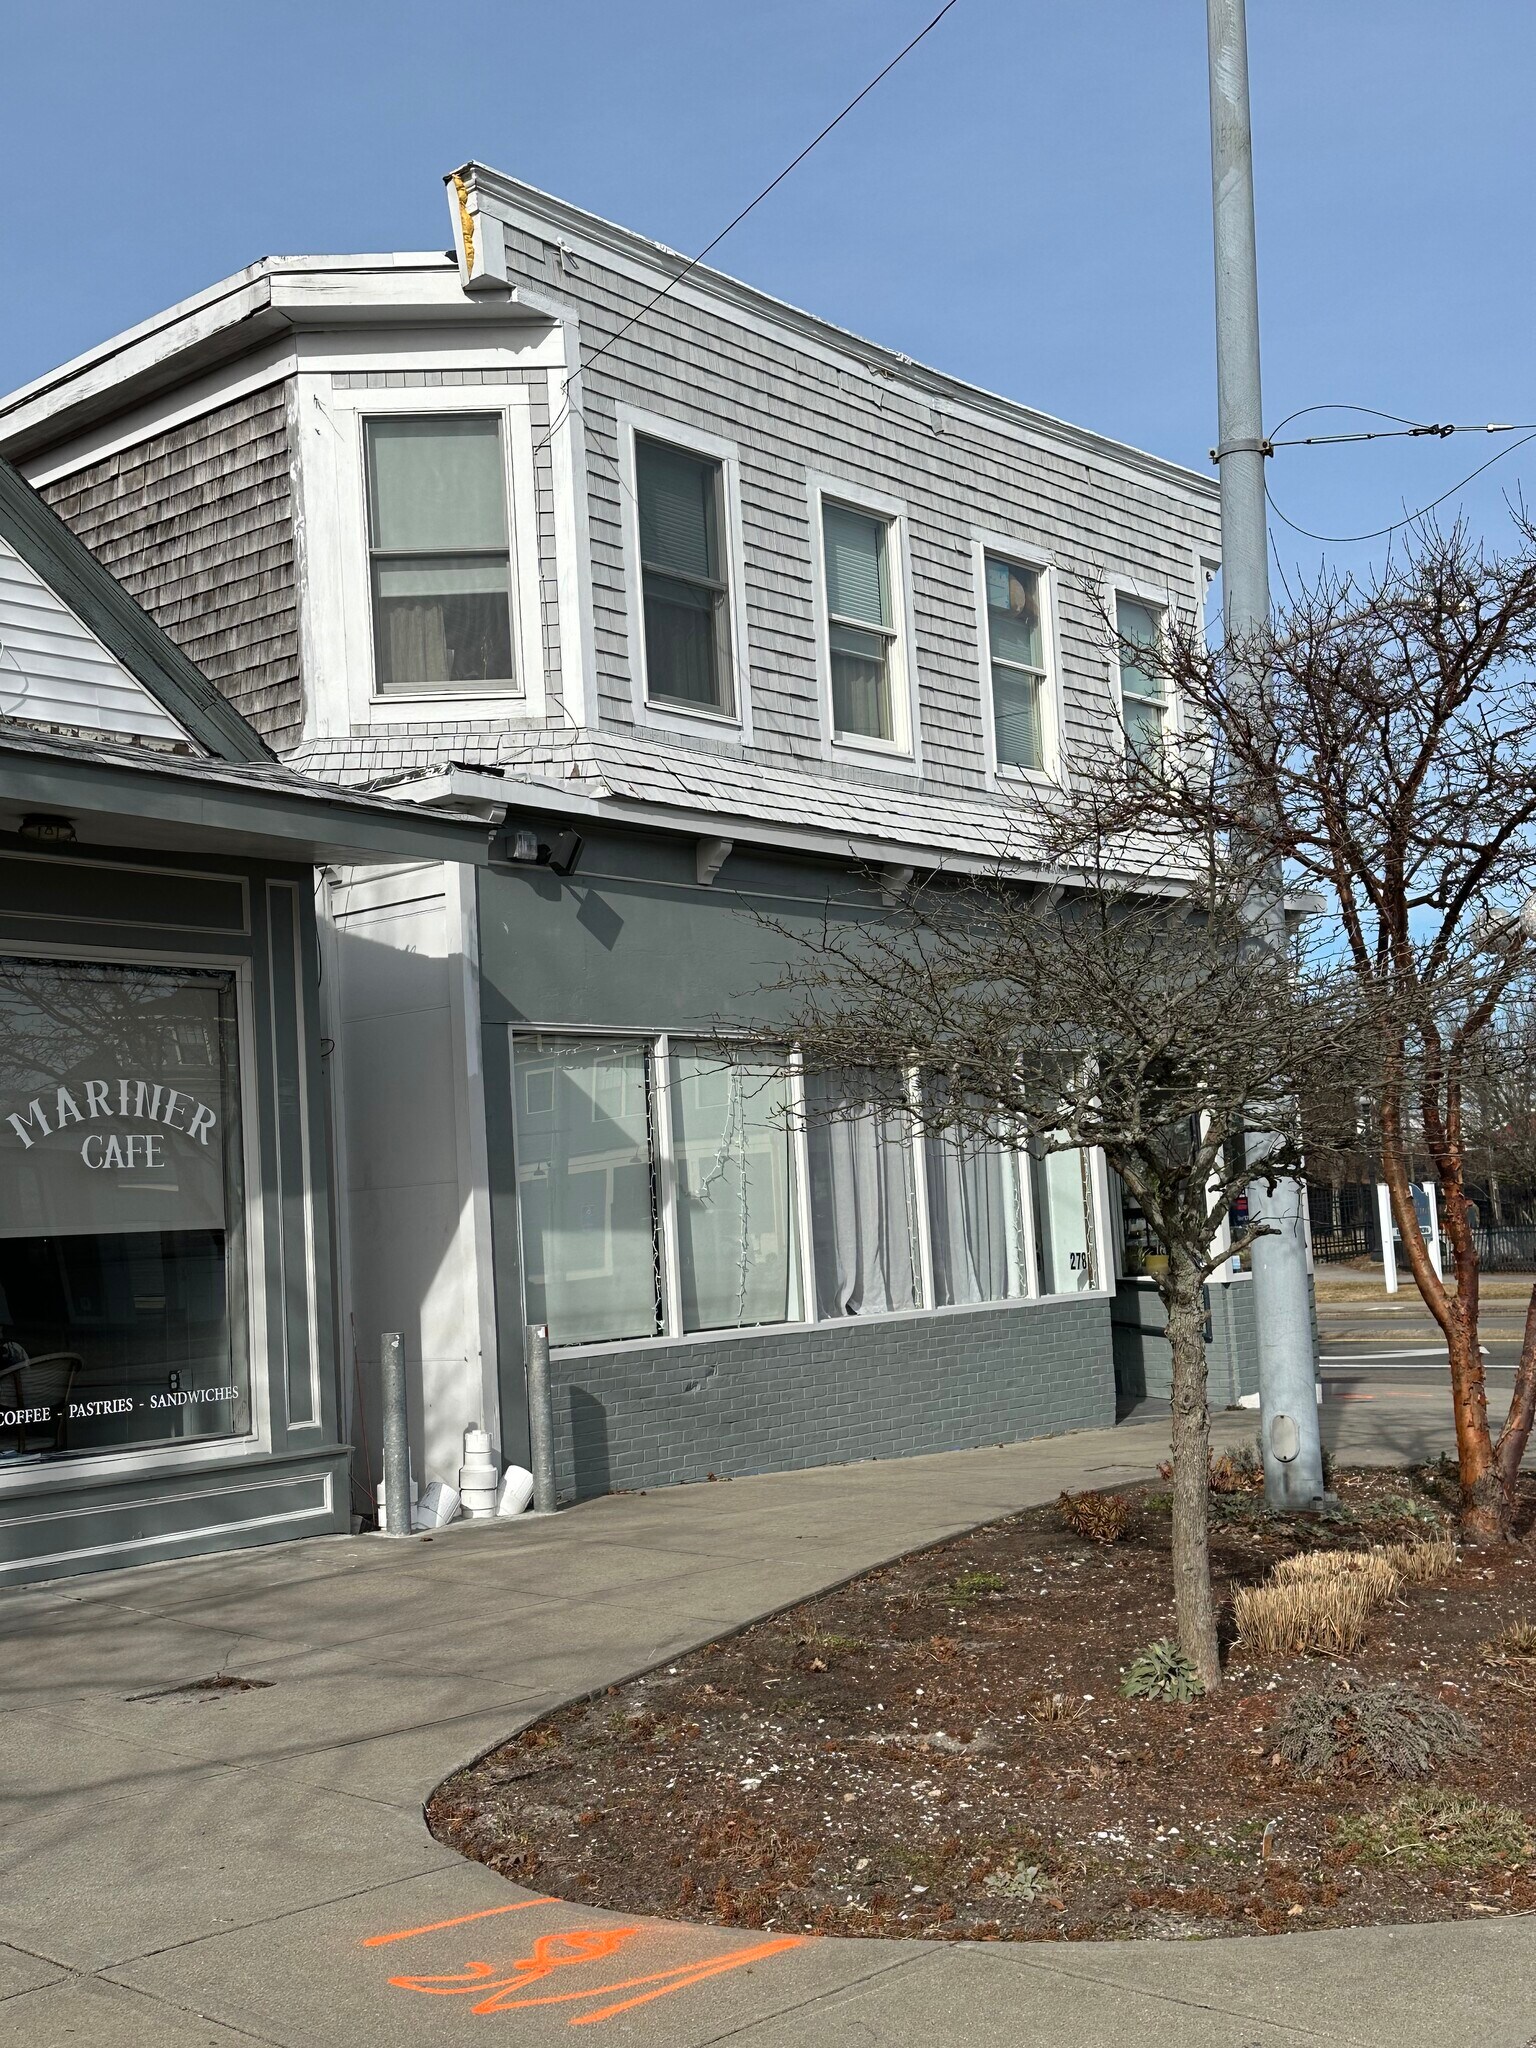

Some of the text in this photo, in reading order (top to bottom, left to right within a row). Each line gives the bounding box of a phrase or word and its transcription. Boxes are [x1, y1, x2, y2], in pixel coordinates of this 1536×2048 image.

[6, 1079, 217, 1149] MARINER
[81, 1134, 165, 1169] CAFE
[1070, 1252, 1087, 1270] 278
[69, 1398, 133, 1418] PASTRIES
[150, 1386, 239, 1409] SANDWICHES
